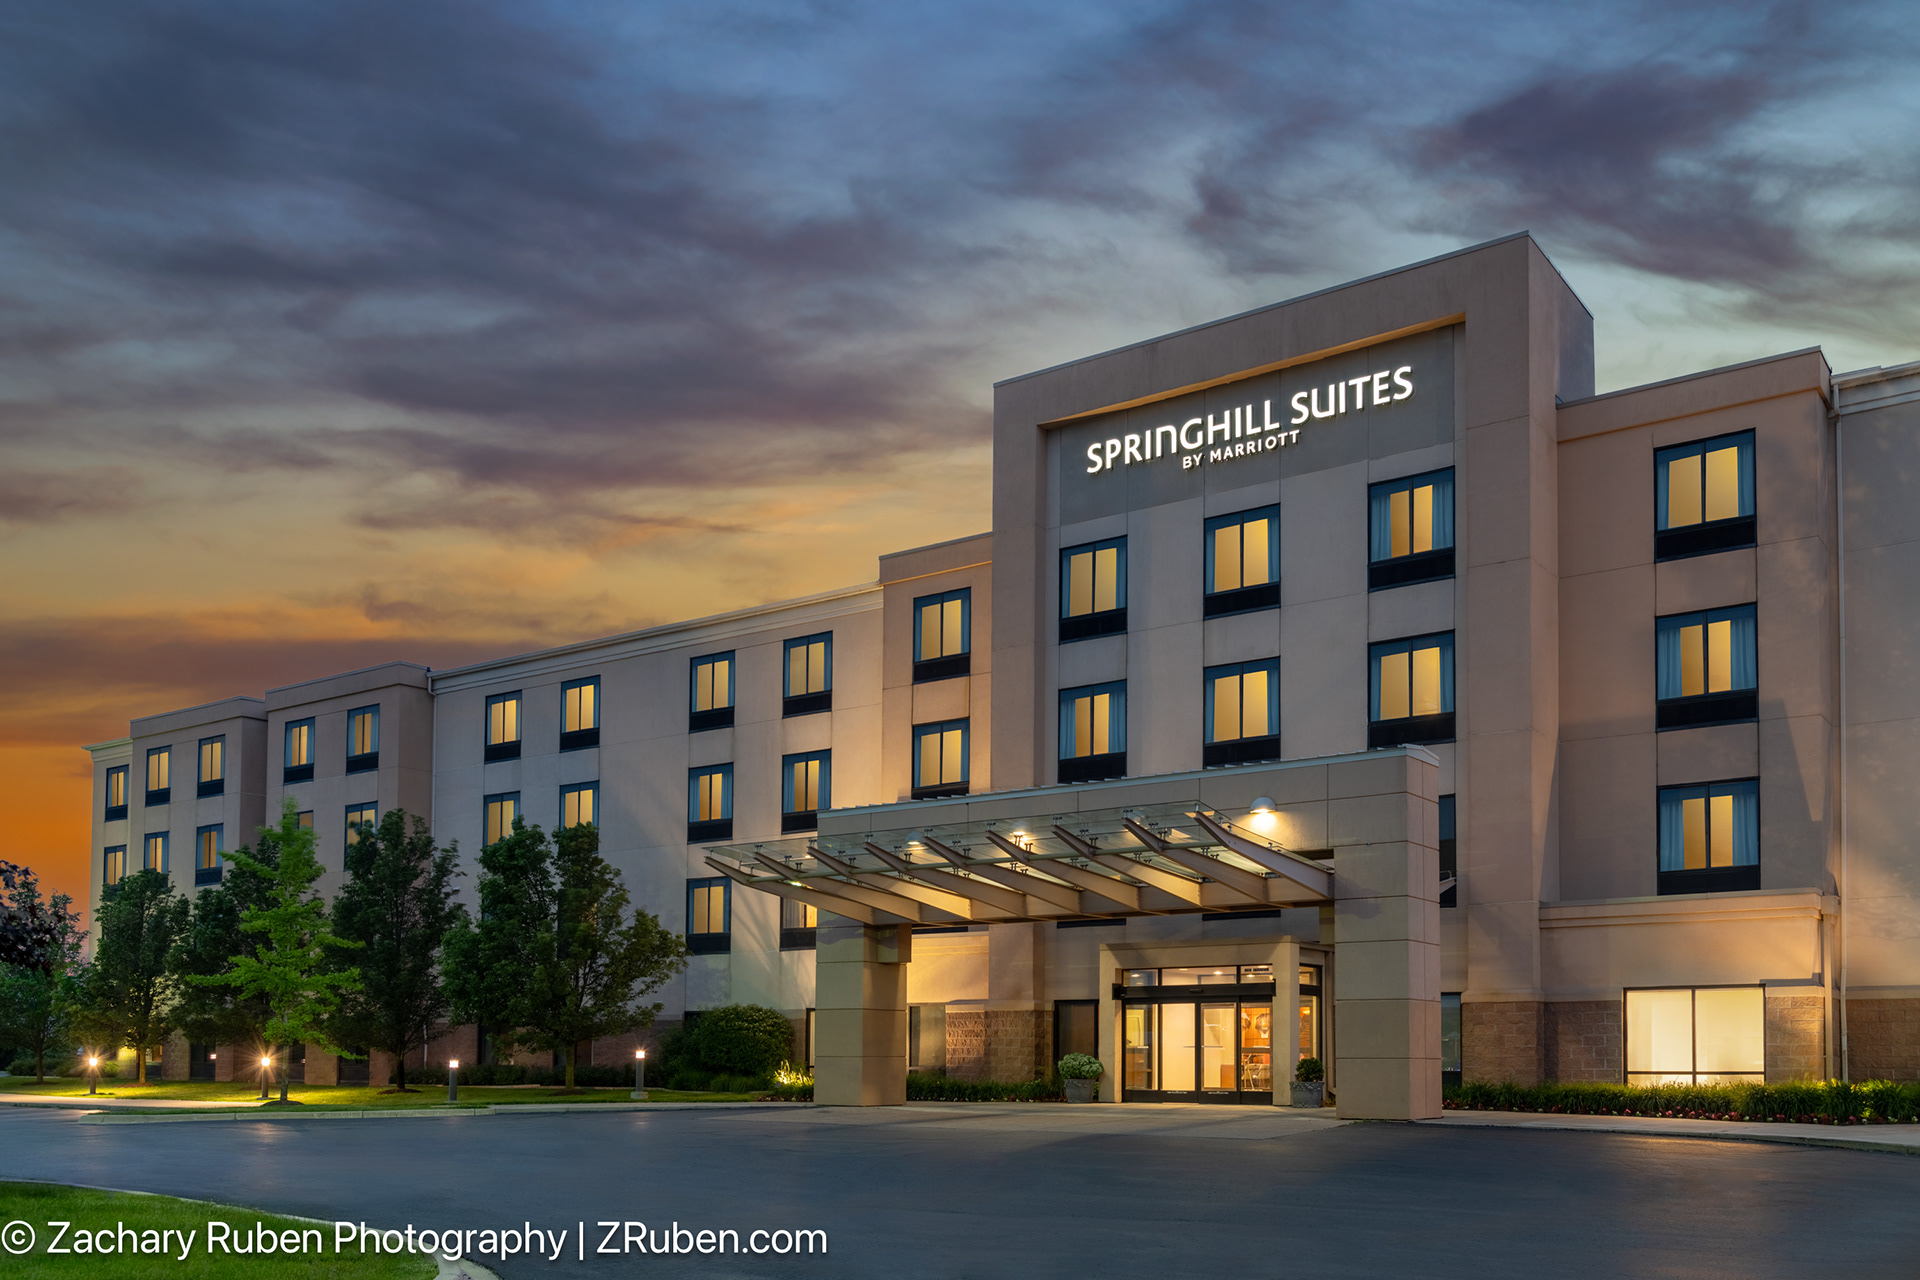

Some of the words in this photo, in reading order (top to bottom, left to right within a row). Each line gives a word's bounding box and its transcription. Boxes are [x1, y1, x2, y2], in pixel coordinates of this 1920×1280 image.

[1086, 399, 1280, 474] SPRINGHILL
[1290, 365, 1413, 425] SUITES
[1182, 452, 1203, 470] BY
[1209, 429, 1300, 463] MARRIOTT
